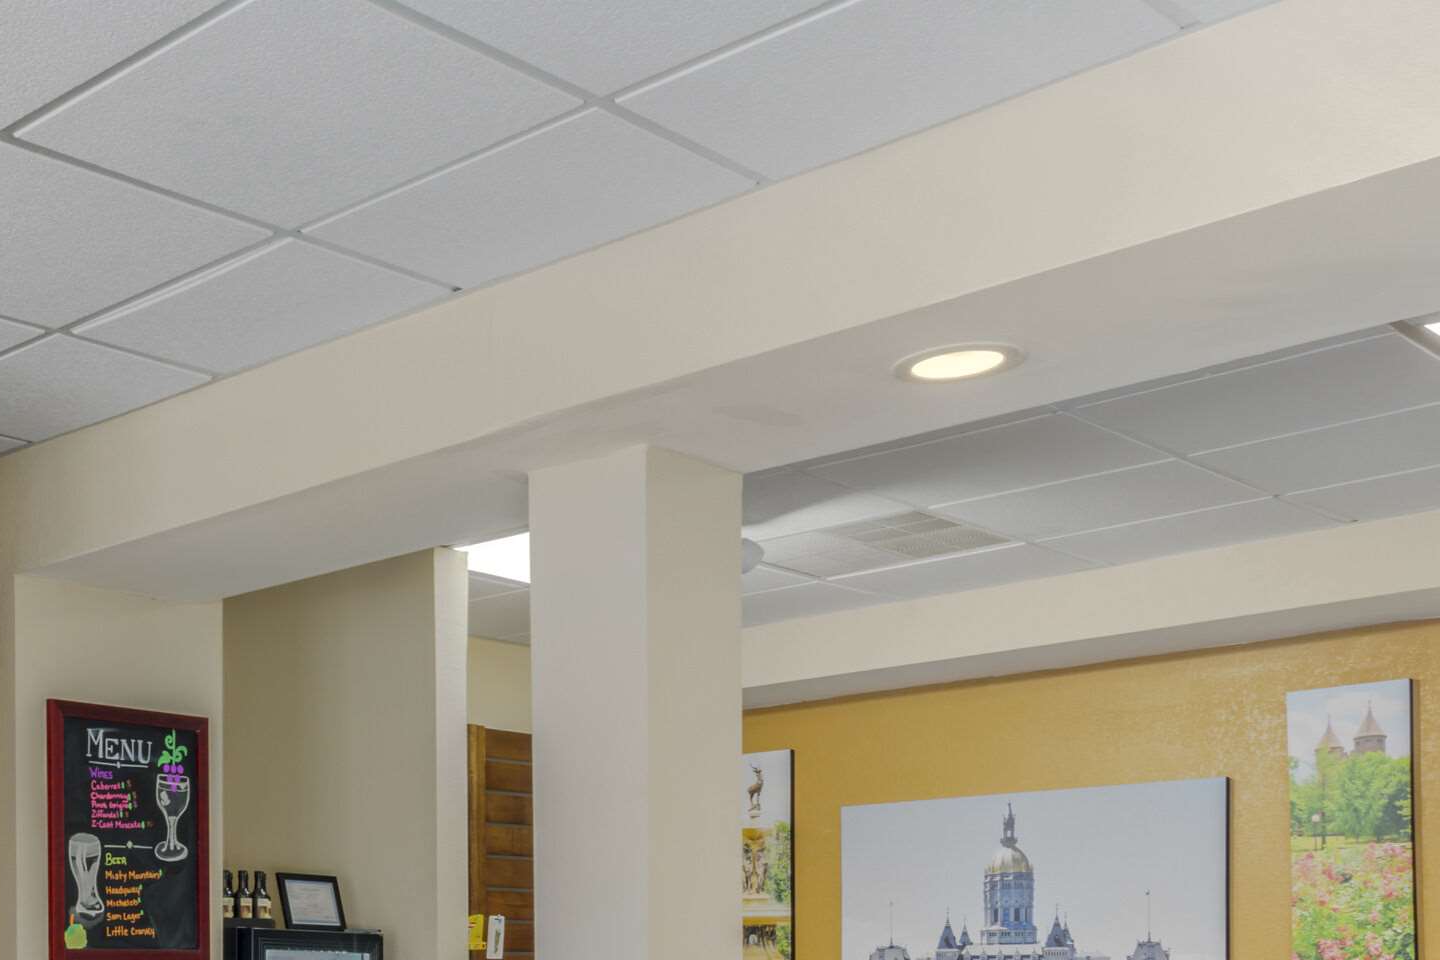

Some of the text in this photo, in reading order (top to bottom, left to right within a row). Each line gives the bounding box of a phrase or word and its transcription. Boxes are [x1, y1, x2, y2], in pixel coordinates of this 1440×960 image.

[85, 728, 152, 764] MENU
[105, 870, 127, 881] Misty
[106, 926, 128, 936] Little
